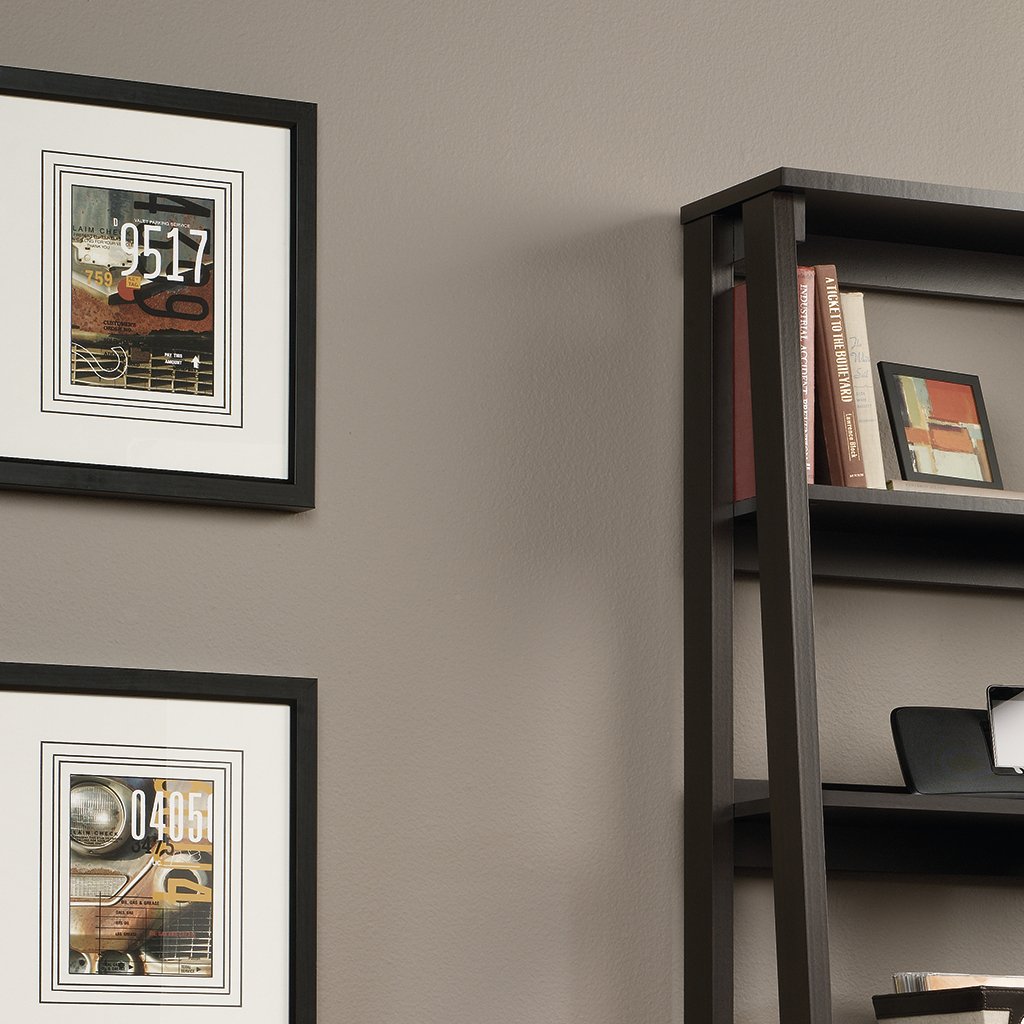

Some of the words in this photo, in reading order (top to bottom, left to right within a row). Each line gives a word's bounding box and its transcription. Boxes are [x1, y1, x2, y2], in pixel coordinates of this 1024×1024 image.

[120, 222, 208, 284] 9517
[85, 269, 113, 287] 759
[800, 284, 808, 341] INDUSTRIAL
[826, 285, 842, 319] TICKET
[831, 320, 843, 332] TO
[833, 333, 845, 350] THE
